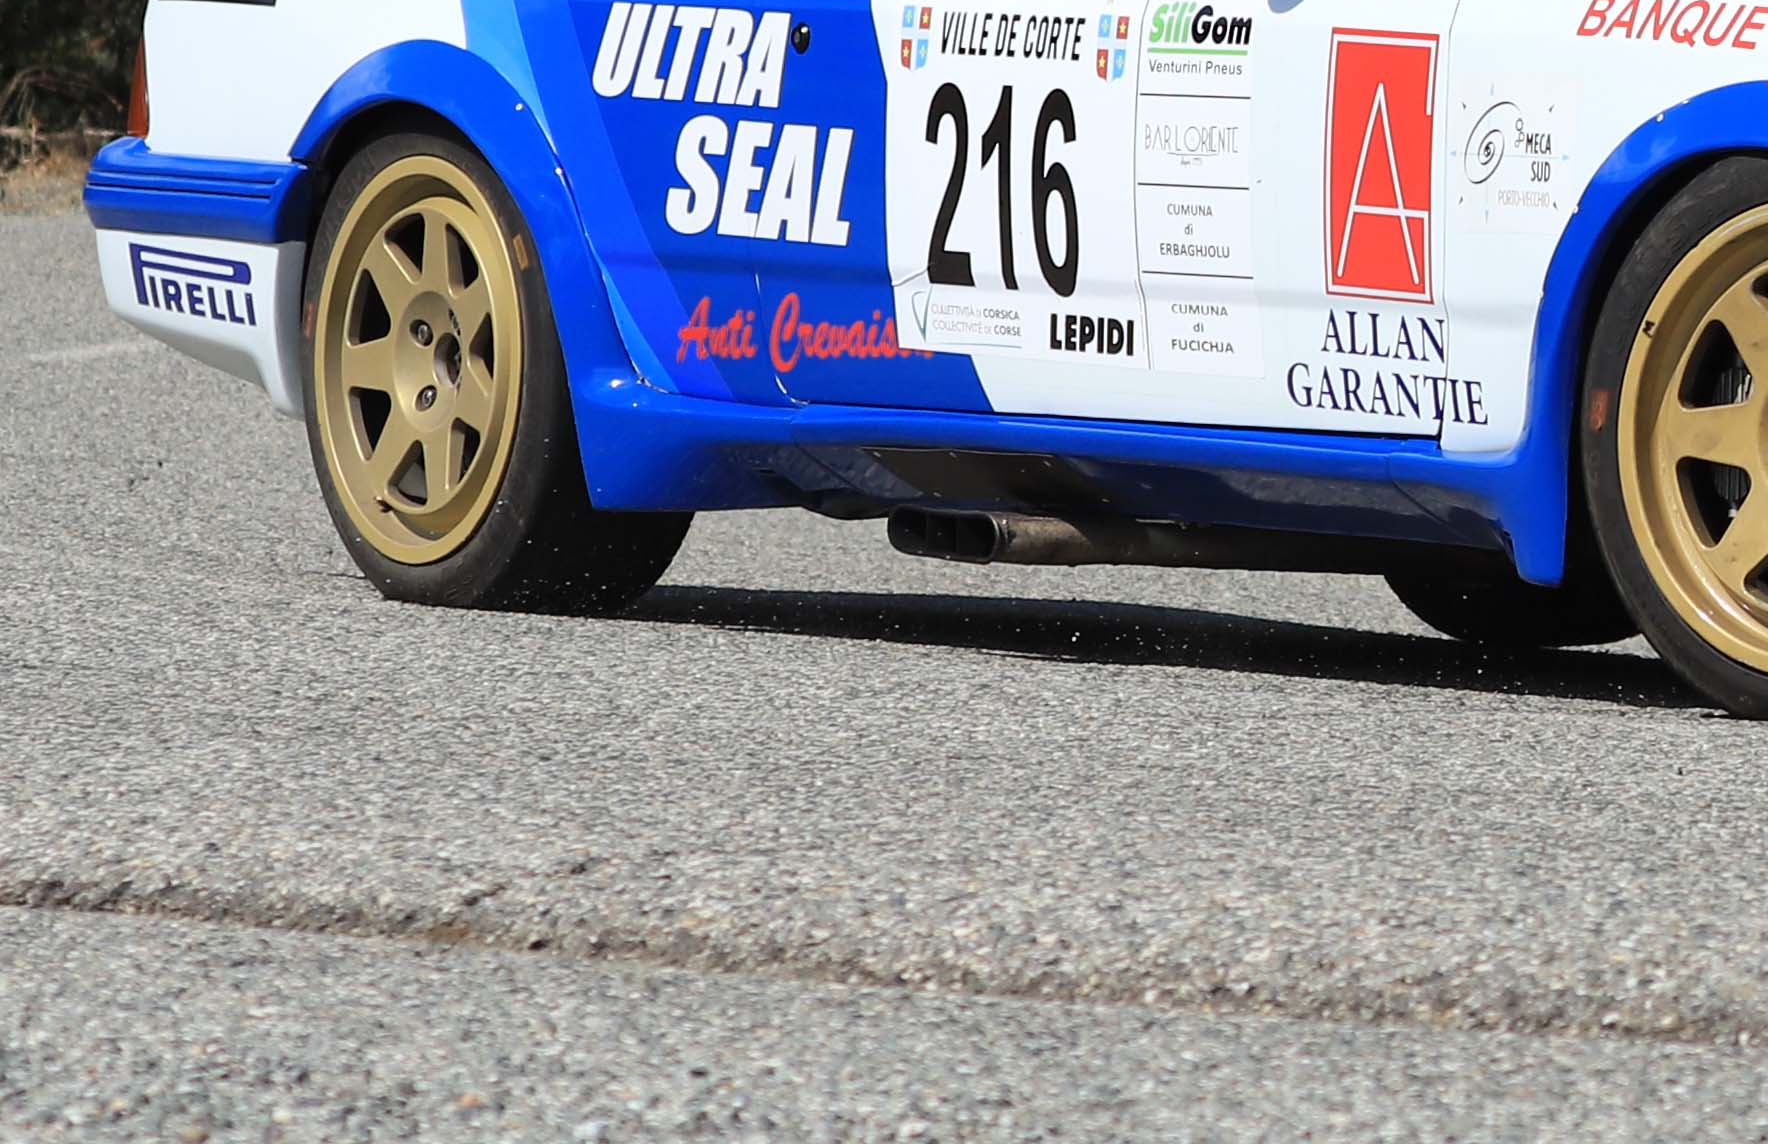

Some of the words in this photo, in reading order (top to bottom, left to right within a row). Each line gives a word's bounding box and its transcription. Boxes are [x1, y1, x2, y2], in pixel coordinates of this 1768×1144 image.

[940, 11, 993, 55] VILLE
[994, 13, 1021, 57] DE
[1023, 15, 1086, 62] CORTE
[1148, 1, 1253, 46] SiliGom
[591, 0, 792, 109] ULTRA
[1148, 58, 1201, 74] Venturini
[1204, 60, 1243, 77] Pneus
[1144, 123, 1171, 151] BAR
[1524, 132, 1553, 155] MECA
[664, 113, 856, 247] SEAL
[925, 82, 1080, 298] 216
[1530, 161, 1552, 183] SUD
[1166, 202, 1213, 217] CUMUNA
[1184, 223, 1194, 236] di
[129, 242, 258, 327] PIRELLI
[983, 307, 1020, 321] CORSICA
[1171, 302, 1229, 318] CUMUNA
[1193, 320, 1205, 334] di
[676, 296, 758, 364] Anti
[769, 292, 935, 374] Crevais
[993, 324, 1022, 337] CORSE
[1049, 313, 1136, 357] LEPIDI
[1320, 308, 1446, 364] ALLAN
[1286, 362, 1489, 426] GARANTIE
